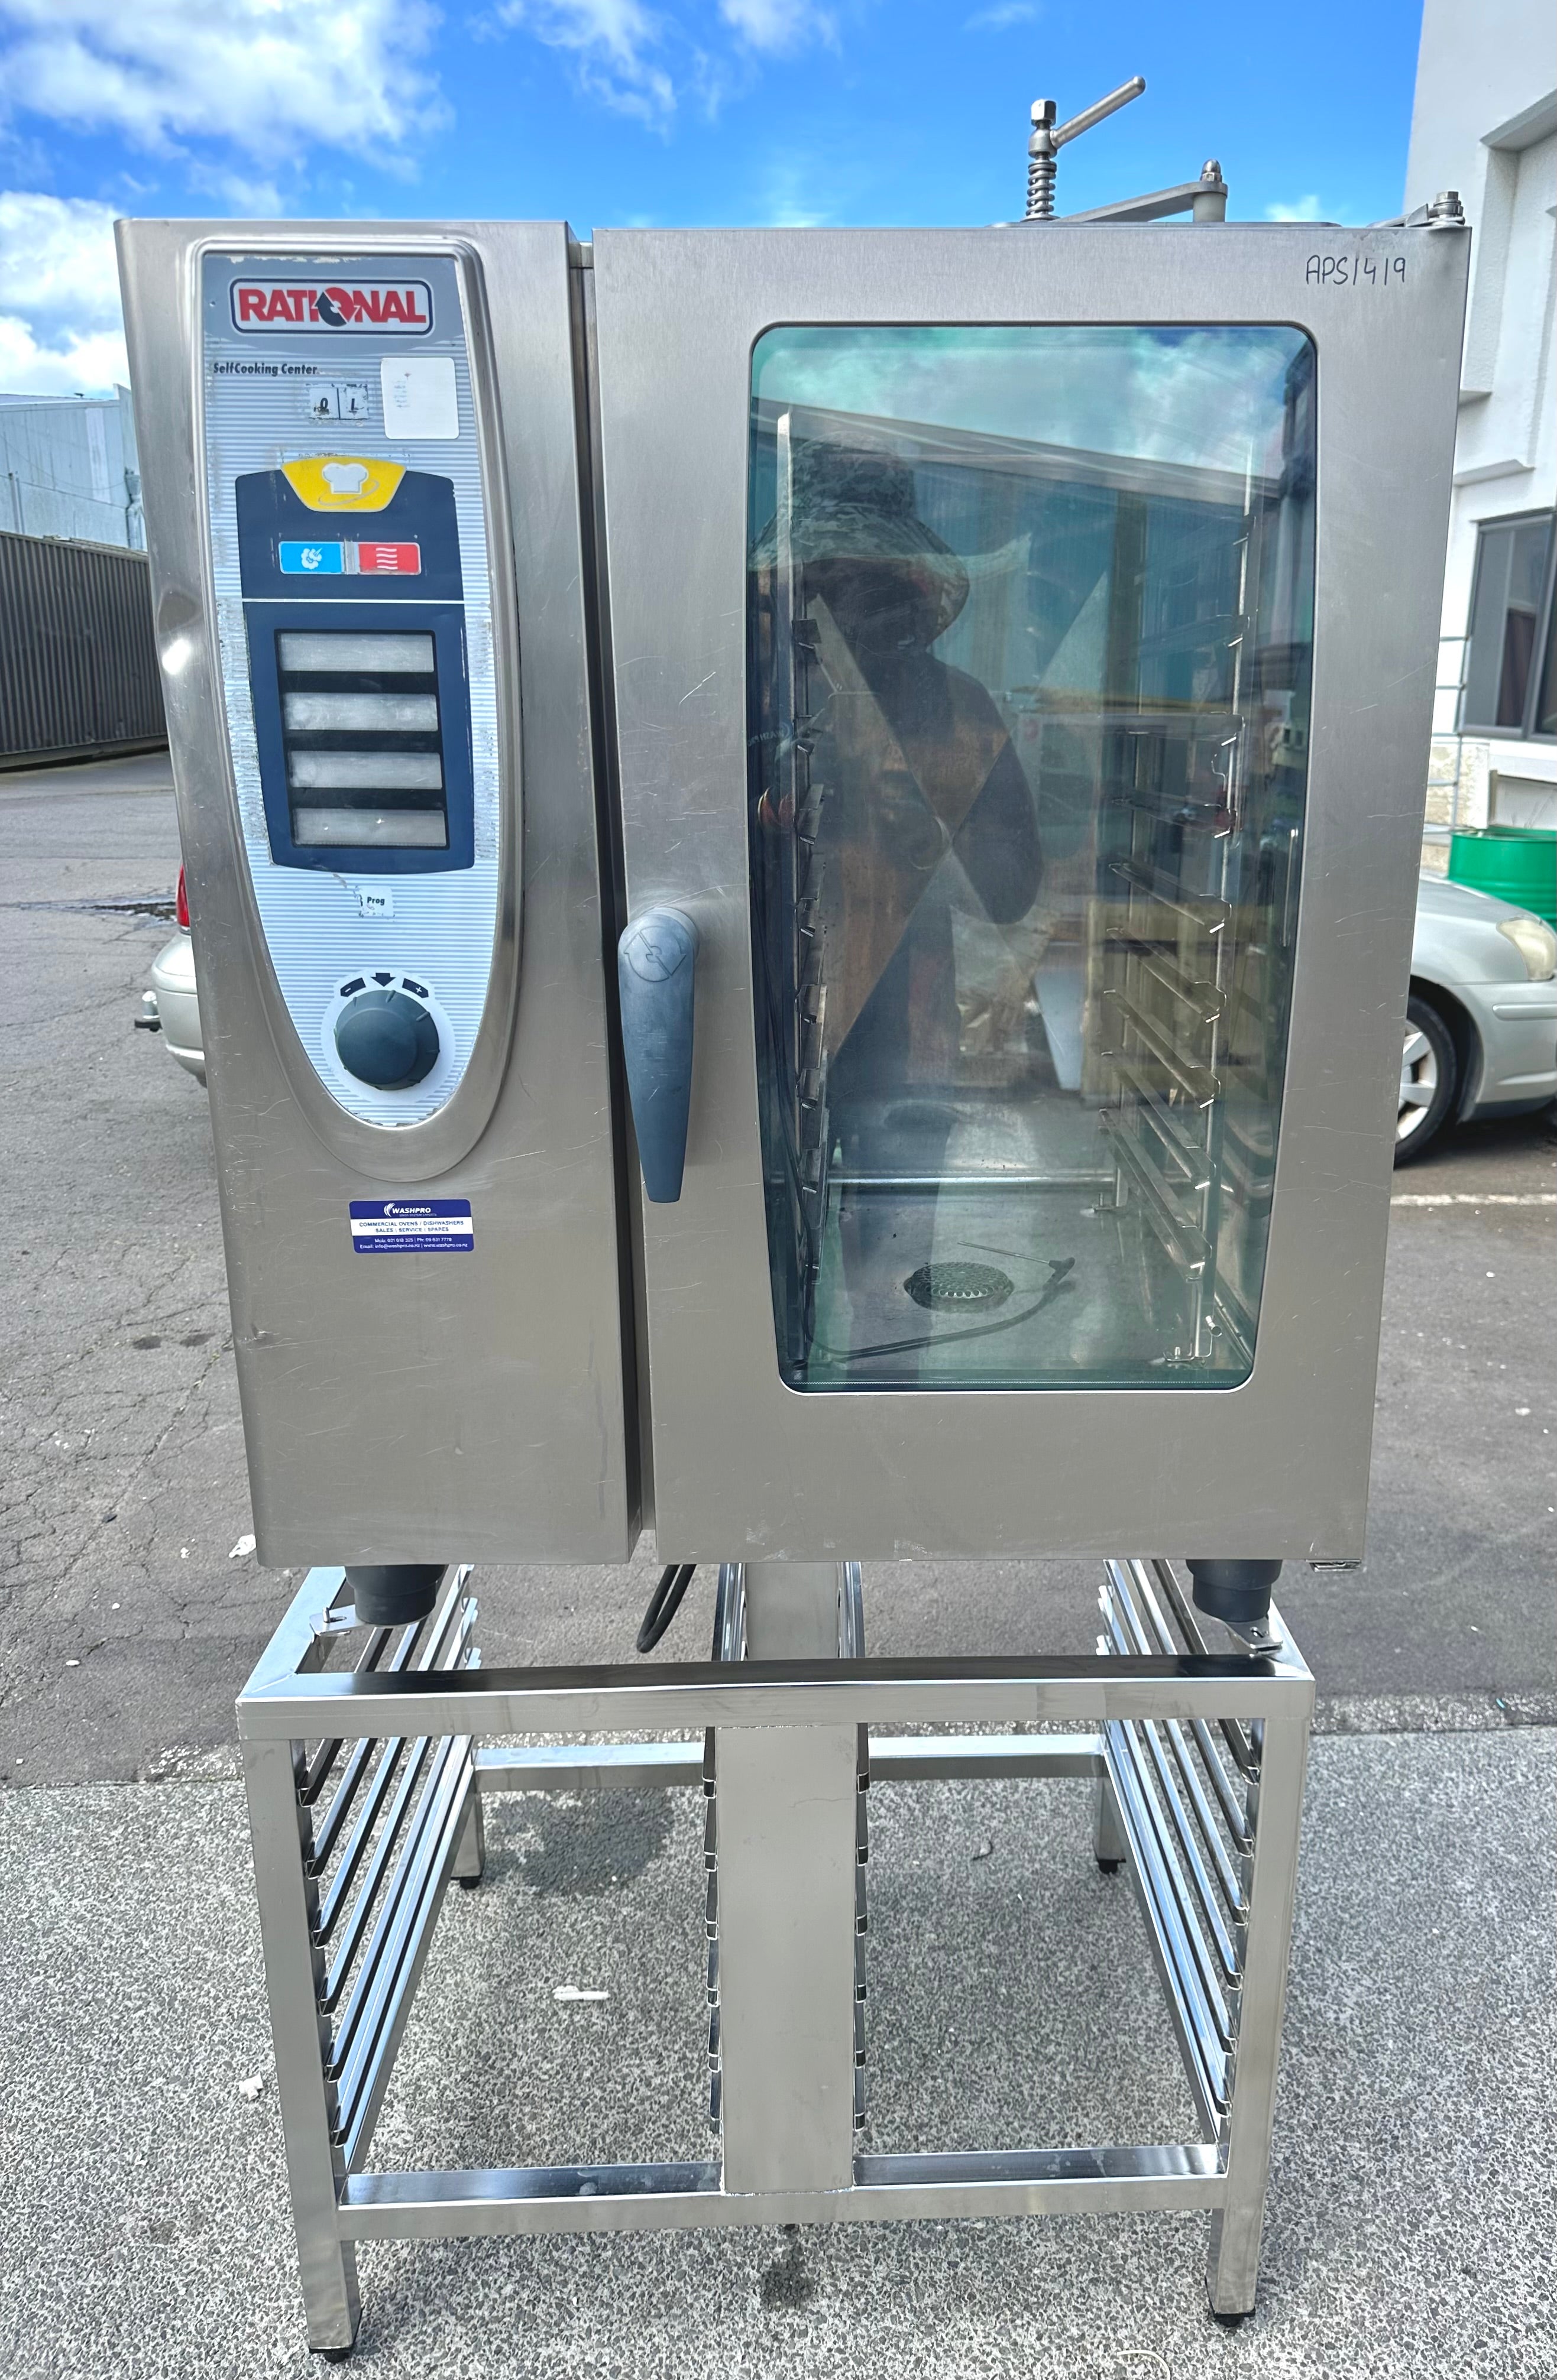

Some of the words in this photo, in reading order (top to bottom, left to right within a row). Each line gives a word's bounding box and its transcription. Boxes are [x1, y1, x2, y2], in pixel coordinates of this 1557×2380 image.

[238, 287, 427, 328] RATIONAL
[213, 362, 279, 377] SelfCooking
[367, 897, 385, 906] Prog
